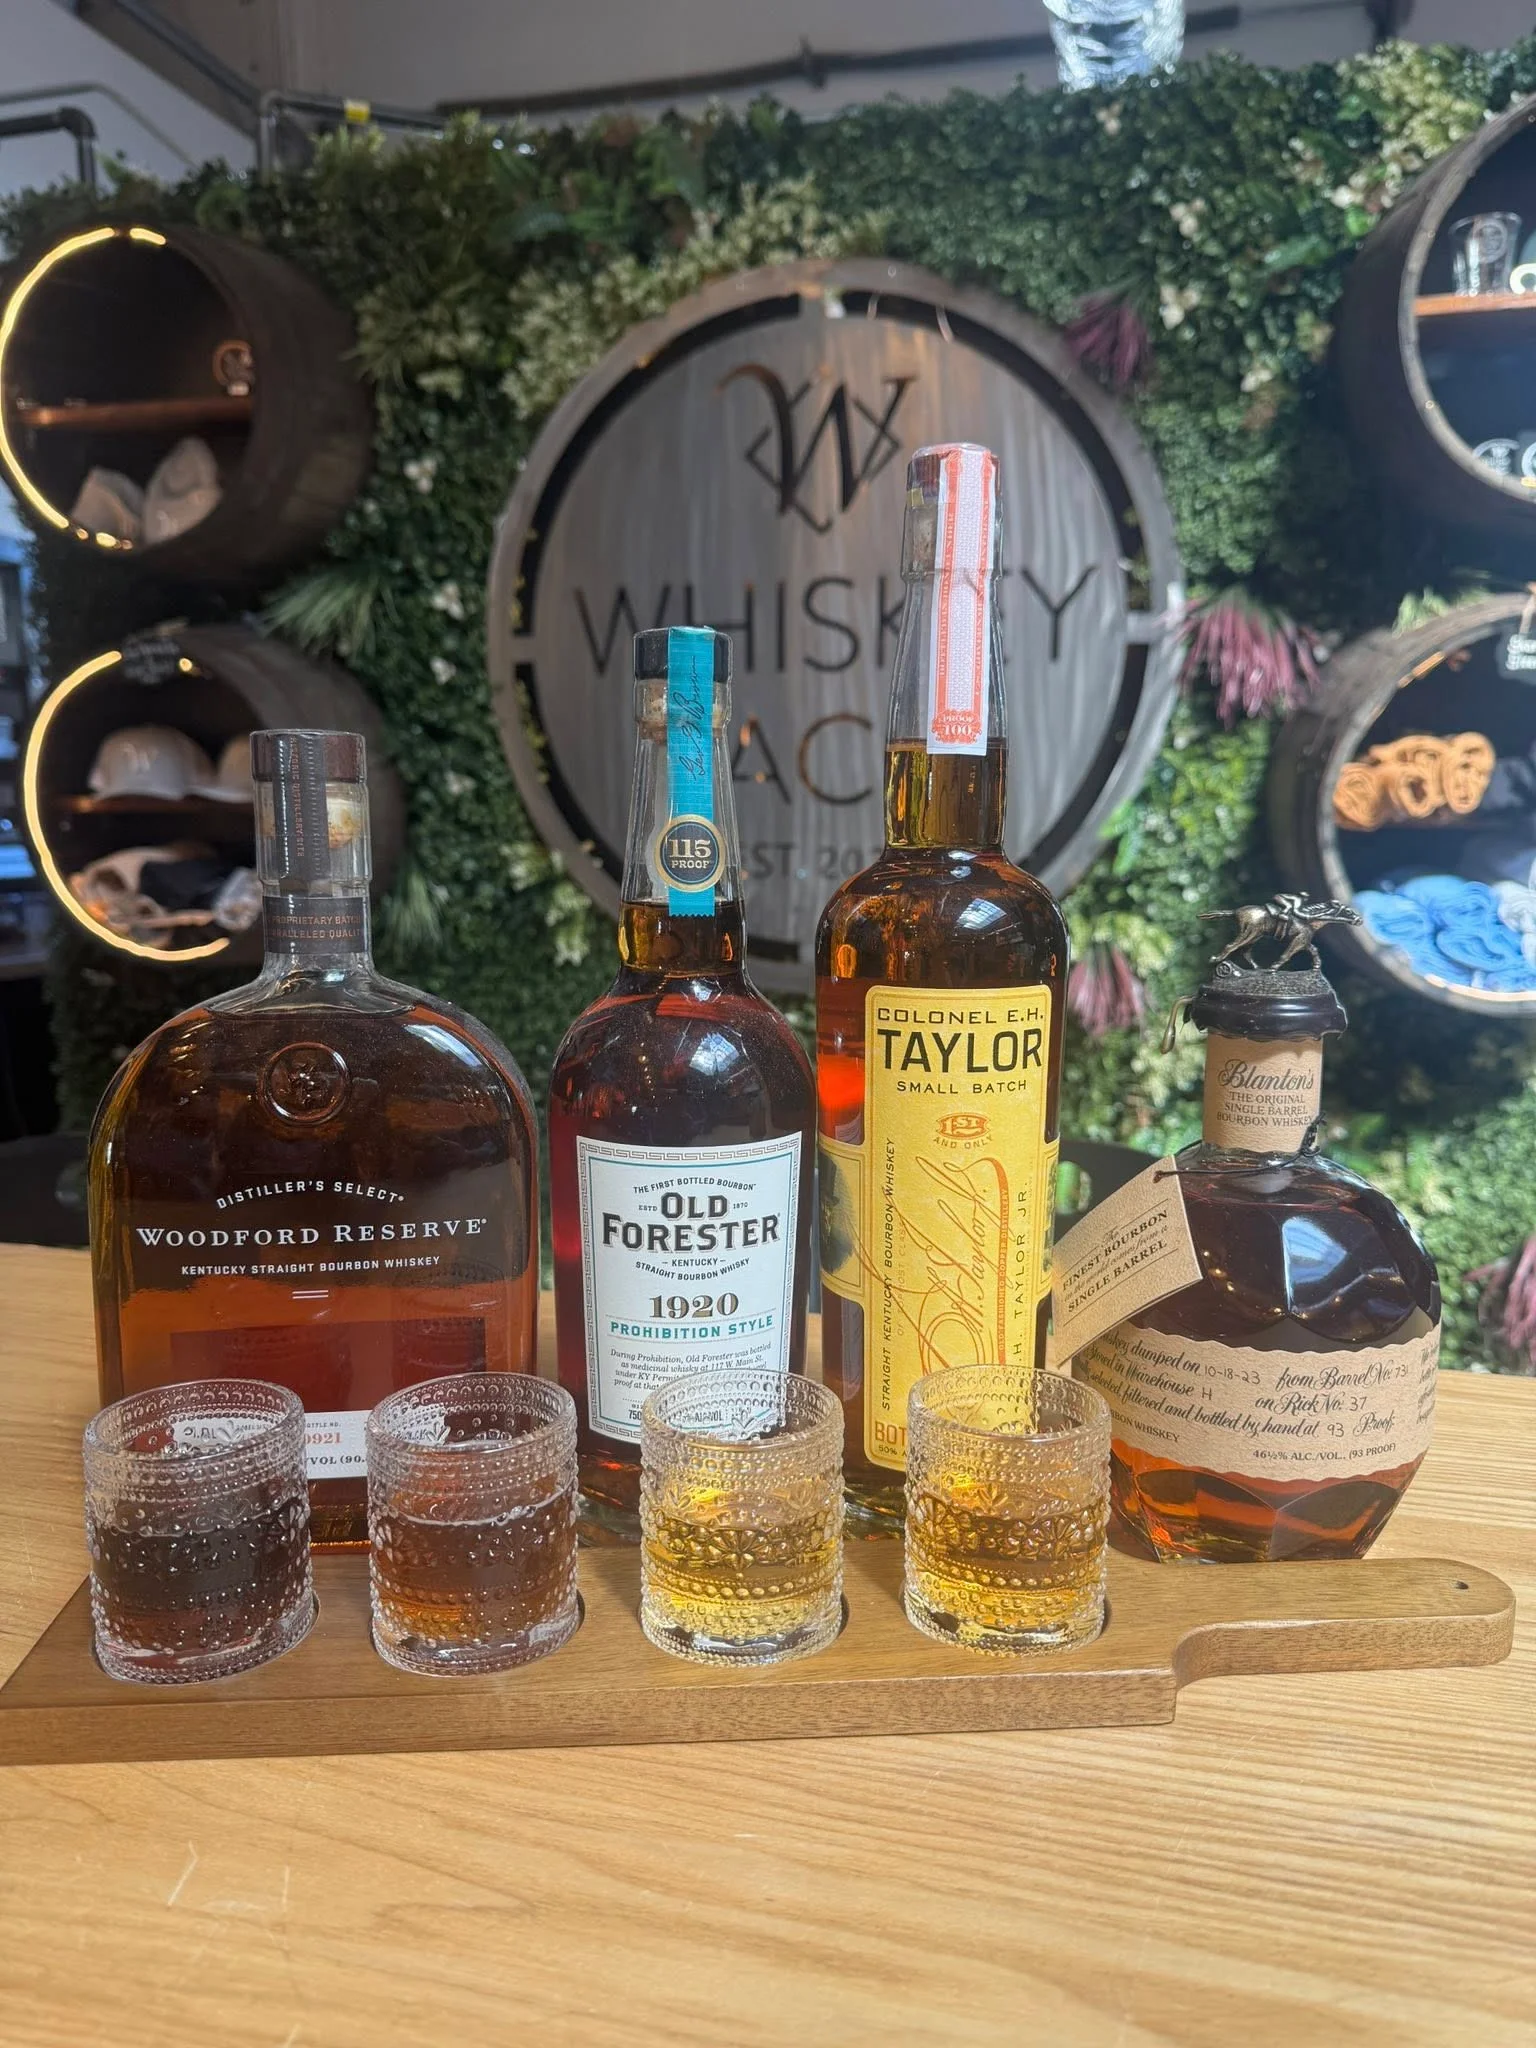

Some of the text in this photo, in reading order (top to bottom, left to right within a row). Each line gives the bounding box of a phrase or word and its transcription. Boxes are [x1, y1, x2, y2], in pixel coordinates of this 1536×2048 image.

[574, 562, 1100, 680] WHISKY
[944, 724, 972, 736] 100
[668, 838, 712, 859] 115
[671, 859, 710, 870] PROOF
[877, 1007, 1045, 1025] COLONEL E.H.
[877, 1028, 1042, 1073] TAYLOR
[1218, 1058, 1315, 1090] Blanton's
[896, 1079, 1027, 1095] SMALL BATCH
[1228, 1091, 1306, 1106] THE ORIGINAL
[1216, 1111, 1313, 1128] BOURBON WHISKEY
[1224, 1102, 1308, 1117] SINGLE BARREL
[932, 1134, 994, 1149] AND ONLY
[216, 1179, 326, 1210] DISTILLER'S
[633, 1185, 650, 1195] THE
[650, 1178, 675, 1191] FIRST
[677, 1177, 715, 1186] BOTTLED
[638, 1192, 749, 1221] ESTD OLD 1870
[1017, 1182, 1028, 1219] JR.
[136, 1218, 483, 1248] WOODFORD RESERVE
[601, 1211, 781, 1254] FORESTER
[671, 1257, 719, 1267] KENTUCKY
[1062, 1210, 1169, 1291] FINEST BOURBON
[181, 1255, 441, 1276] KENTUCKY STRAIGHT BOURBON WHISKEY
[635, 1257, 751, 1281] STRAIGHT BOURBON WHISKY
[881, 1137, 896, 1411] STRAIGHT KENTUCKY BOURBON WHISKEY
[1014, 1233, 1027, 1320] TAYLOR
[1068, 1240, 1168, 1313] SINGLE BARREL
[649, 1292, 739, 1320] 1920
[610, 1315, 774, 1339] PROHIBITION STYLE
[610, 1341, 772, 1364] During Prohibition, Old Forester was bottled
[1131, 1340, 1185, 1371] dumped
[1182, 1361, 1201, 1375] on
[615, 1370, 638, 1379] under
[638, 1371, 651, 1381] KY
[620, 1361, 630, 1369] as
[630, 1363, 669, 1373] medicinal
[670, 1363, 699, 1374] whisky
[735, 1358, 754, 1368] Main
[1114, 1357, 1126, 1374] in
[1125, 1360, 1195, 1397] Warehouse
[1204, 1364, 1262, 1386] 10-18-23
[1275, 1367, 1314, 1392] from
[1314, 1362, 1369, 1390] Barrel
[614, 1378, 634, 1390] proof
[1201, 1386, 1214, 1400] H
[1121, 1381, 1167, 1413] filtered
[1164, 1404, 1196, 1425] and
[1194, 1407, 1244, 1432] bottled
[1243, 1413, 1262, 1439] by
[1261, 1416, 1306, 1437] hand
[1303, 1417, 1320, 1438] at
[1254, 1397, 1275, 1409] on
[1274, 1391, 1320, 1417] Rick
[1349, 1396, 1368, 1412] 37
[875, 1420, 907, 1447] BOT
[1134, 1419, 1181, 1443] WHISKEY
[1326, 1422, 1345, 1438] 93
[878, 1444, 898, 1456] 50%
[1348, 1449, 1364, 1461] (93
[1365, 1442, 1397, 1457] PROOF)
